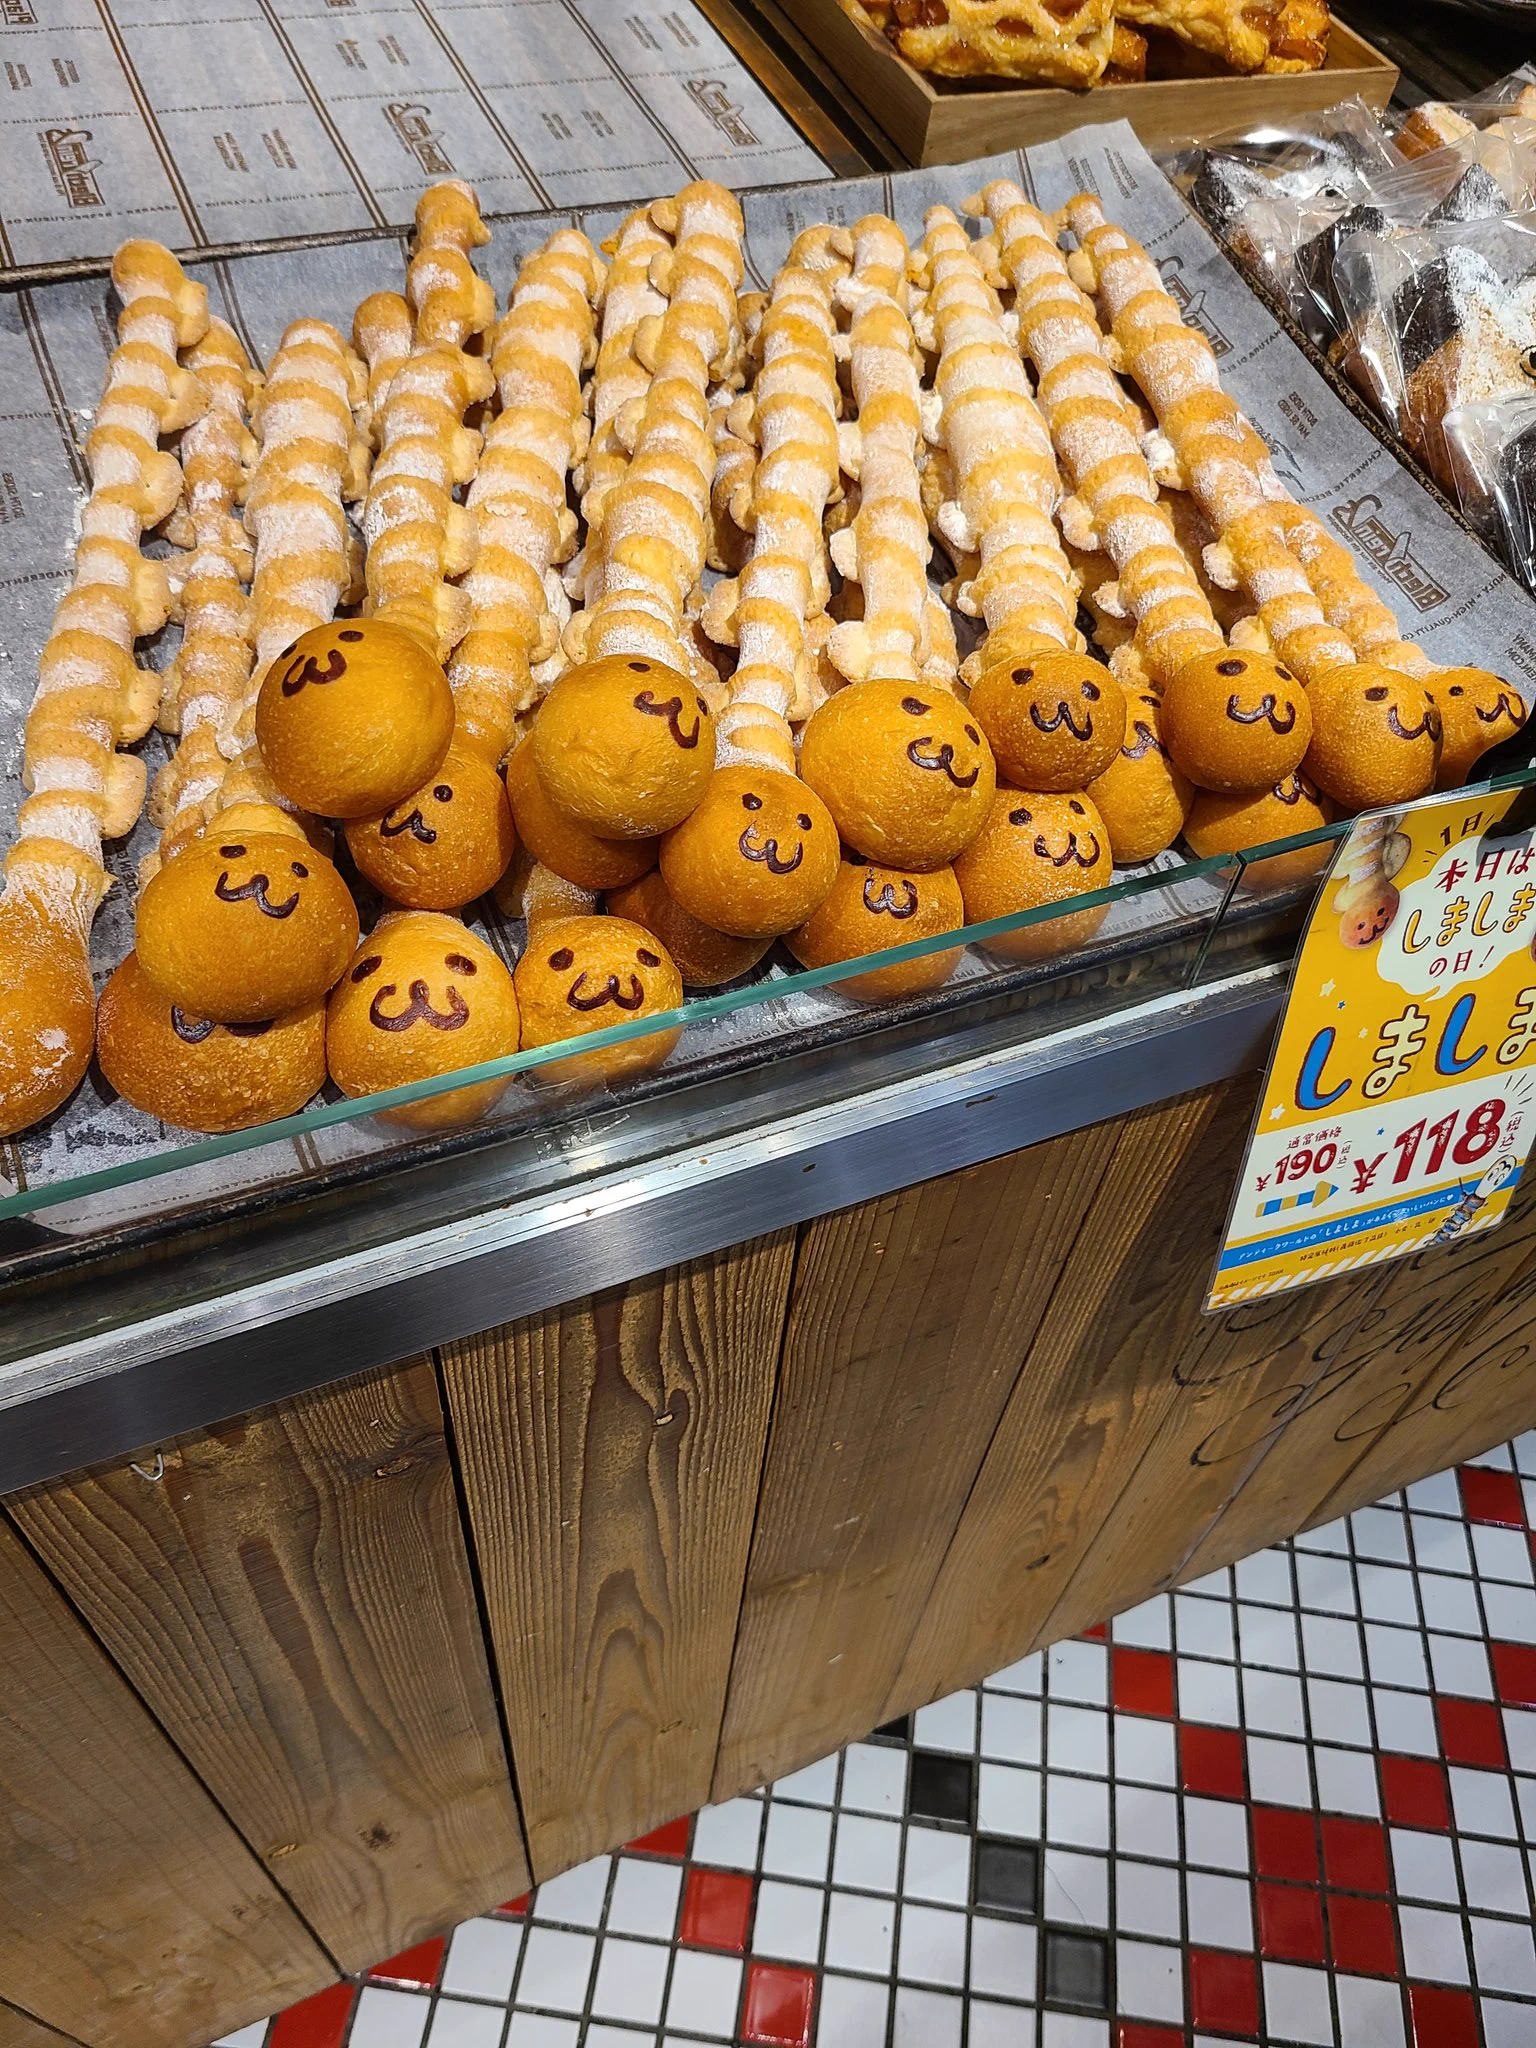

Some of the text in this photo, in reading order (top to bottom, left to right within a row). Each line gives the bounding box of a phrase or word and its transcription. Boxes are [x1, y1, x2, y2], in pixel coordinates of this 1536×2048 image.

[1434, 847, 1536, 893] 本日は
[1402, 883, 1536, 954] しましま
[1295, 986, 1536, 1110] しましま
[1286, 1126, 1342, 1150] 通常価格
